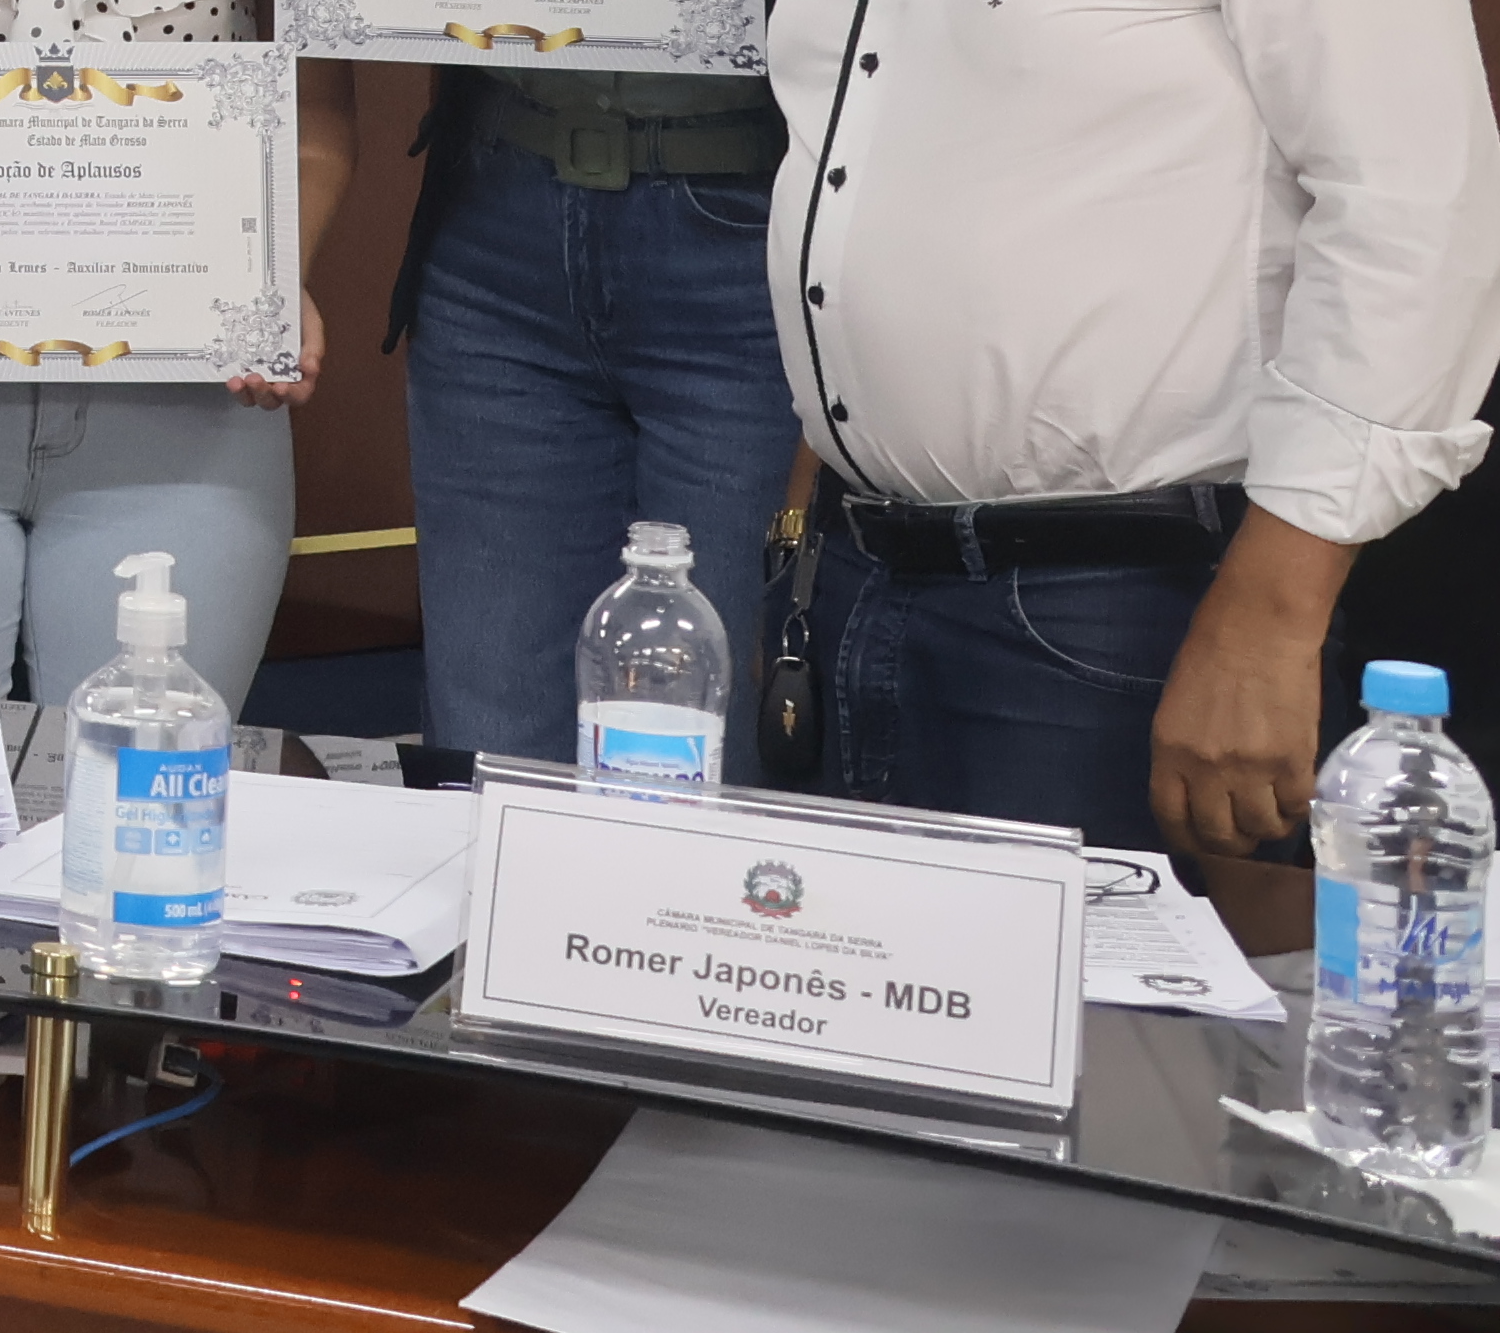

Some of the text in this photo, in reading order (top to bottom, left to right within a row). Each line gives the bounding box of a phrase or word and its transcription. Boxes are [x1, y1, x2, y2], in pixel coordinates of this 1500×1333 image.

[38, 162, 55, 179] de
[61, 161, 141, 181] Aplausos
[67, 261, 115, 273] Auxiliar
[122, 261, 208, 273] Administrativo
[150, 774, 183, 798] All
[566, 933, 682, 975] Romer
[693, 954, 846, 1001] Japonês
[885, 981, 970, 1020] MDB
[699, 995, 827, 1035] Vereador
